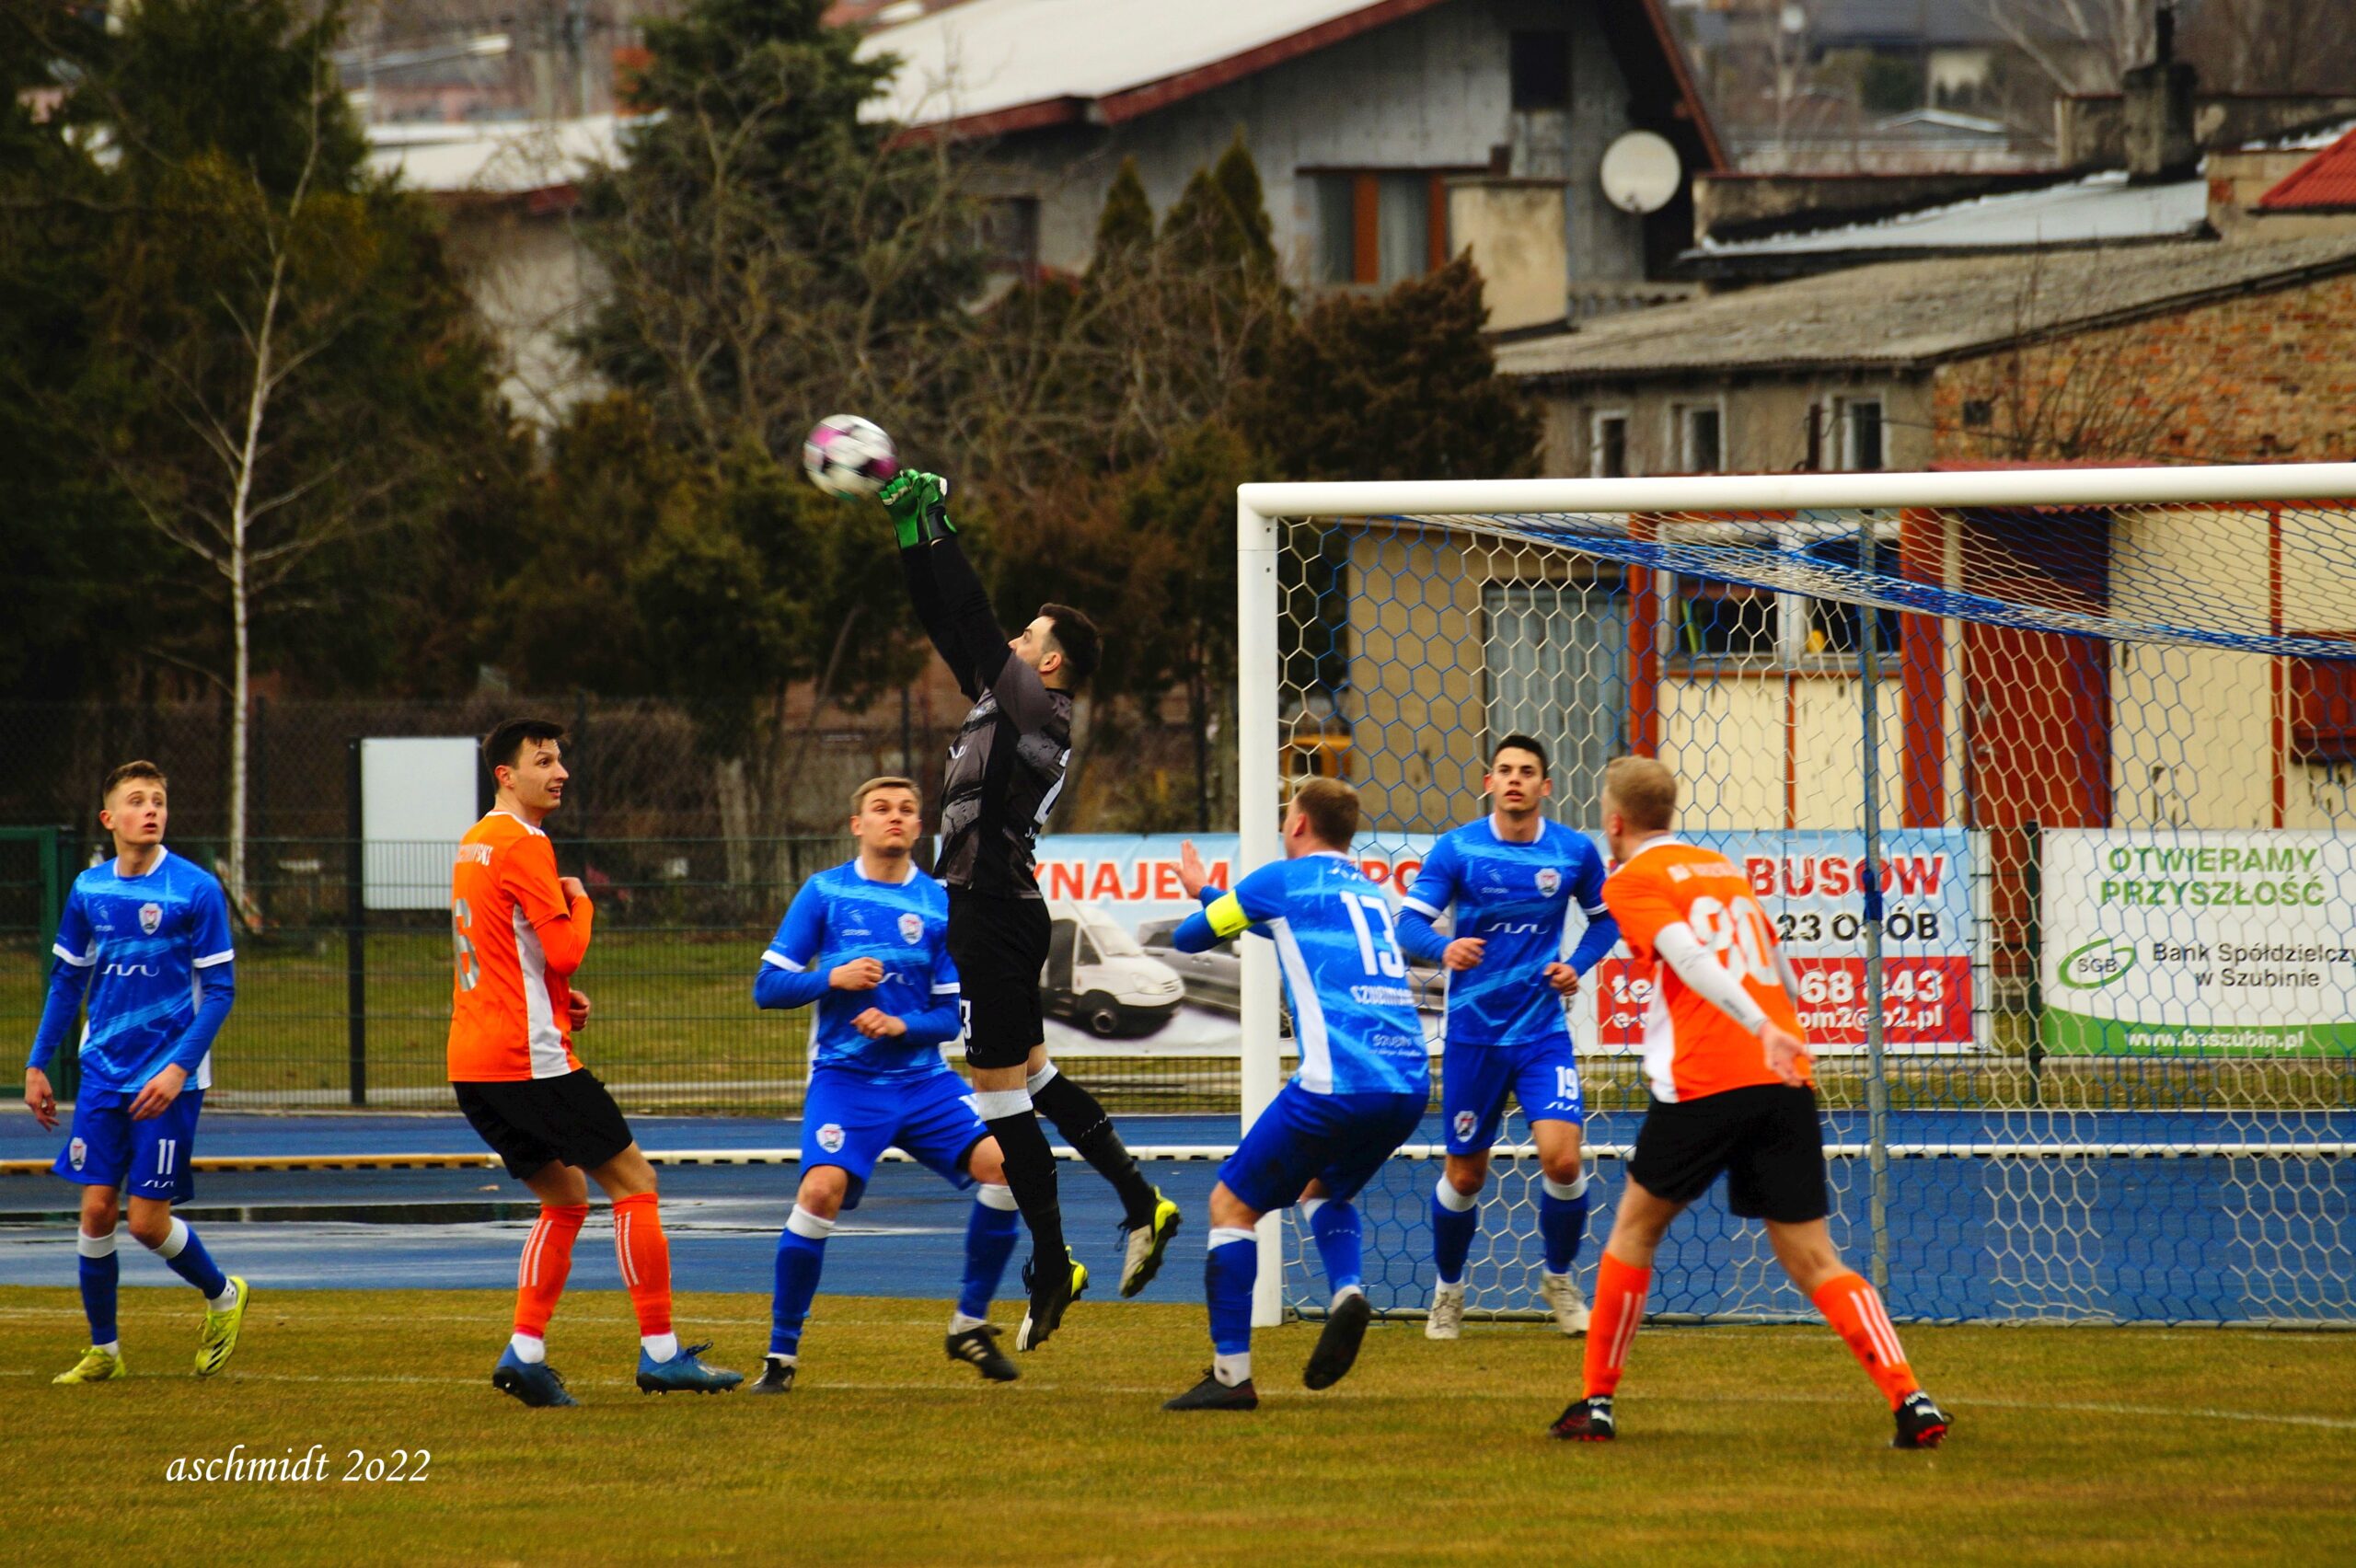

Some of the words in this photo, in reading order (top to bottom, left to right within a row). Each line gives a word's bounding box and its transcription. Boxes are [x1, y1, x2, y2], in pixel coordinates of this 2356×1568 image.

[2108, 847, 2318, 873] OTWIERAMY
[2101, 875, 2326, 906] PRZYSZŁOŚĆ
[1339, 890, 1405, 979] 13
[1832, 905, 1939, 941] OÓB
[2077, 957, 2118, 974] SGB
[2153, 943, 2211, 963] Bank
[2196, 972, 2212, 987] w
[2220, 967, 2321, 988] Szubinie
[1555, 1066, 1579, 1101] 19
[157, 1138, 176, 1175] 11
